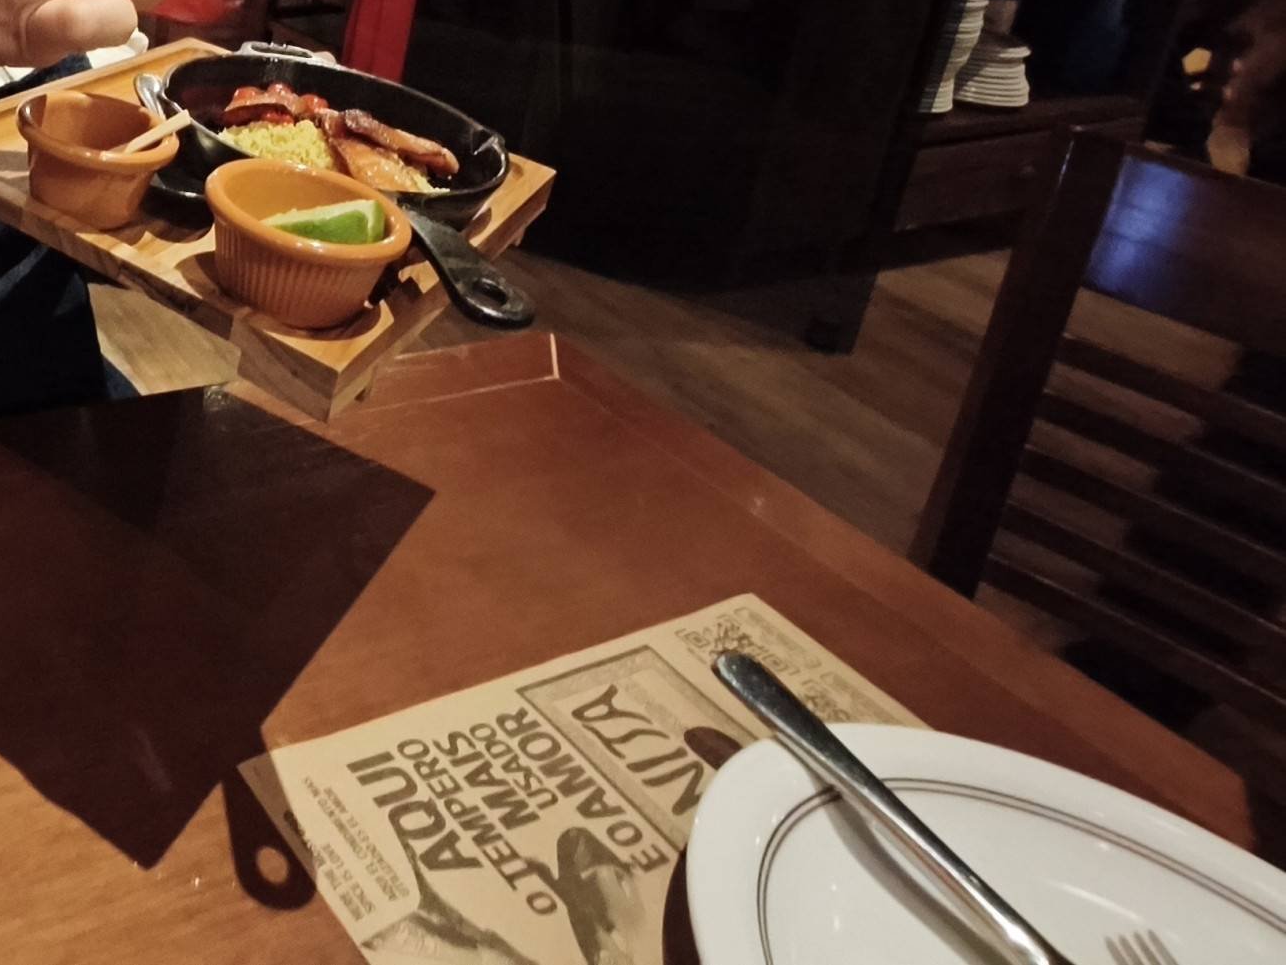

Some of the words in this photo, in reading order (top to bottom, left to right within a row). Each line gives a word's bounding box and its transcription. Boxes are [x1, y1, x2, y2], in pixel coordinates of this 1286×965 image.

[432, 731, 540, 830] MAIS
[469, 723, 558, 810] USADO
[496, 707, 626, 819] AMOR
[571, 684, 702, 815] NITA
[346, 751, 483, 871] AQUI
[397, 739, 531, 891] TEMPERO
[606, 820, 642, 847] O
[526, 891, 557, 915] O
